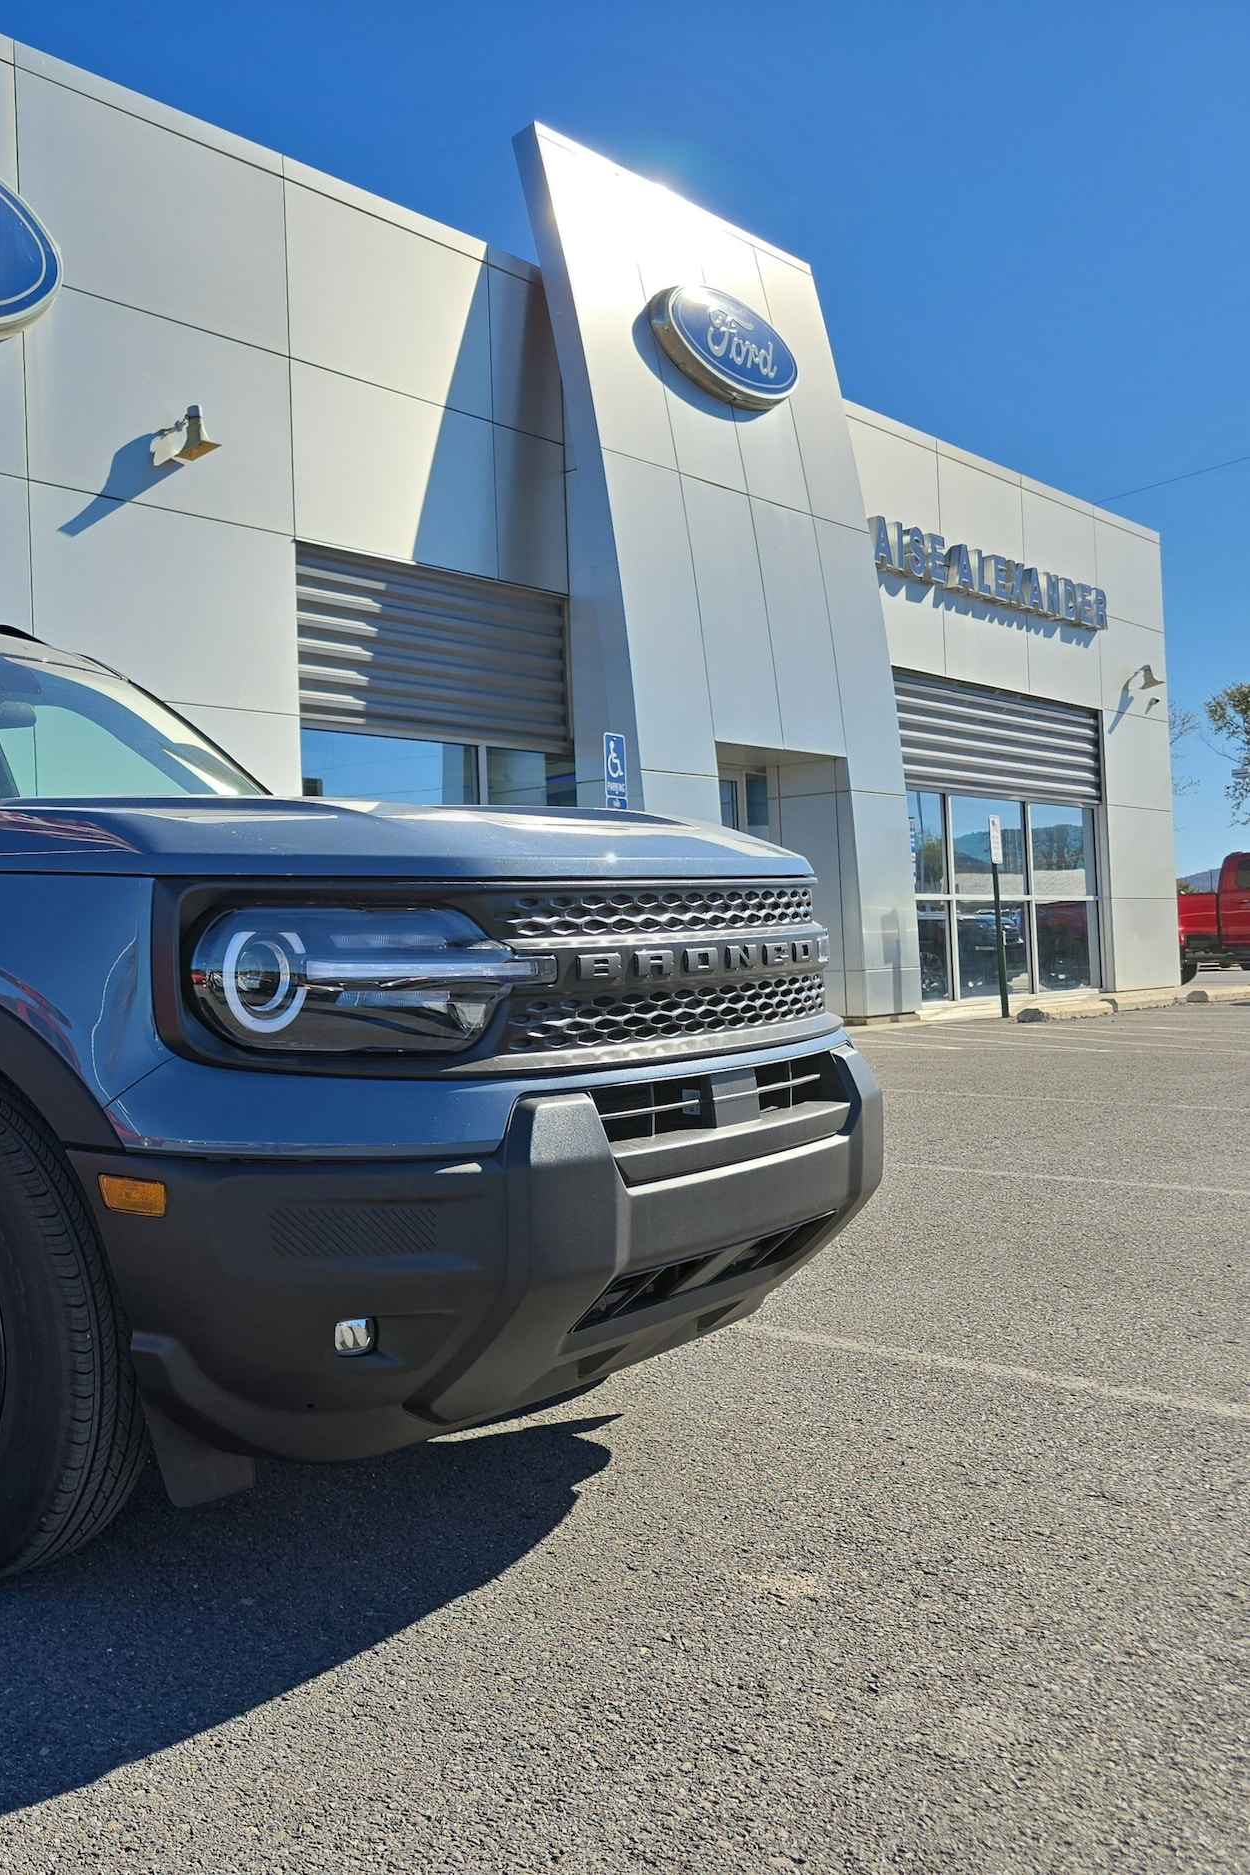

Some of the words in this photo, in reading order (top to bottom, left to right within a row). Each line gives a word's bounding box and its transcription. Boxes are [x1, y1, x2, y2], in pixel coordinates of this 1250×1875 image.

[707, 307, 777, 379] Ford
[946, 543, 1108, 630] ALEXANDER
[607, 781, 626, 792] PARKING
[577, 940, 812, 981] BRONCO
